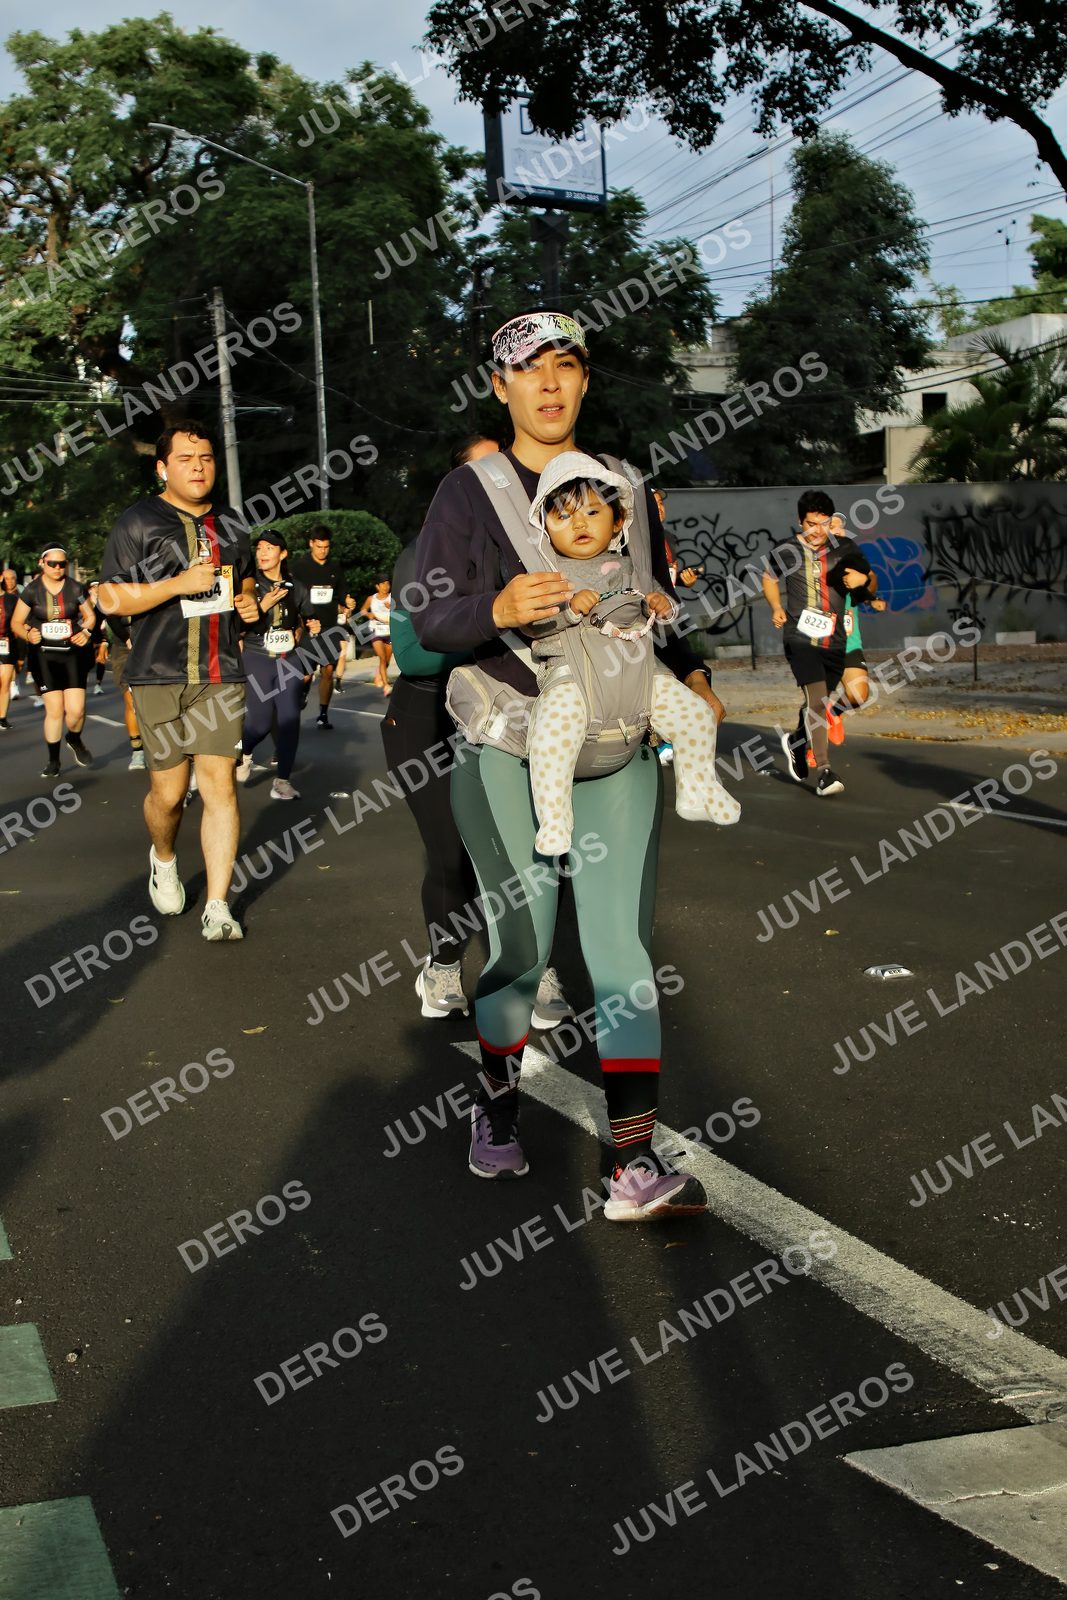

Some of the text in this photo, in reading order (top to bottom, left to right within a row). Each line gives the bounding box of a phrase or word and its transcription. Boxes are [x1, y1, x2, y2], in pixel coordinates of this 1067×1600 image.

[666, 513, 720, 535] TOY
[804, 615, 828, 630] 8225
[269, 634, 289, 644] 5998
